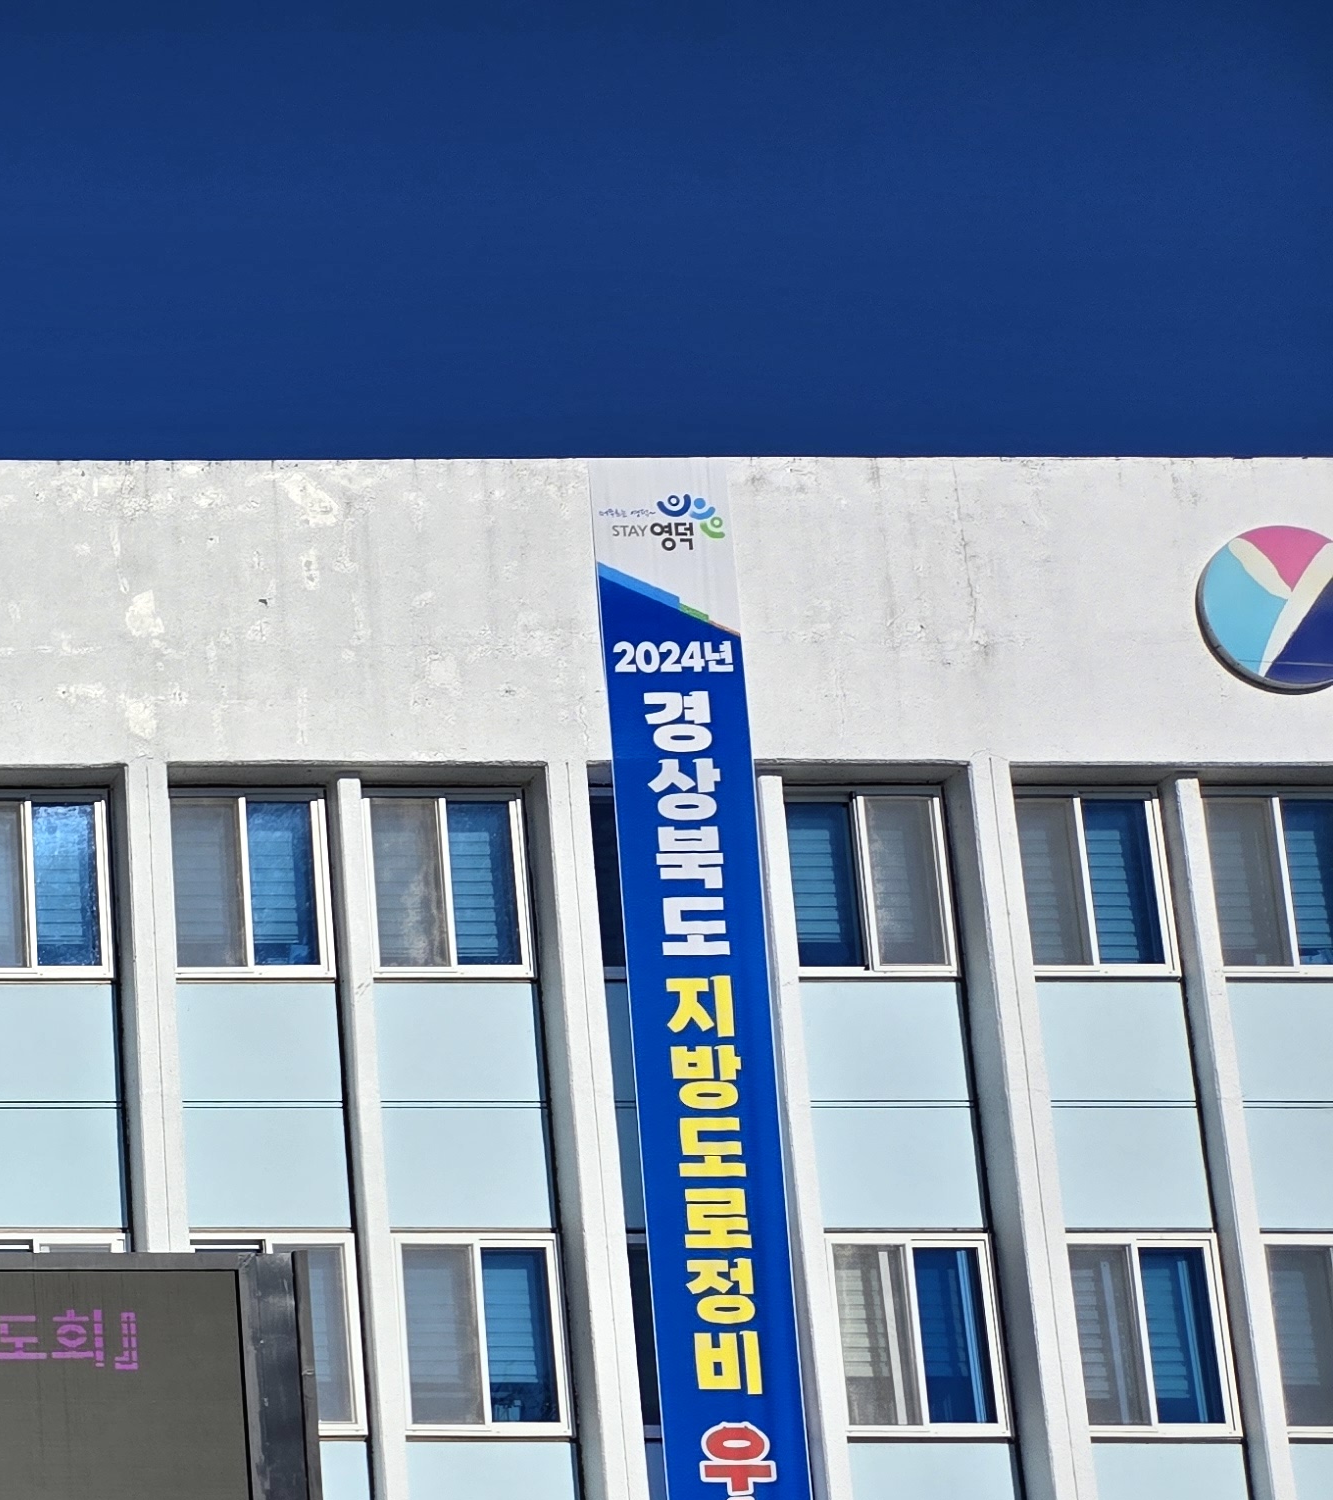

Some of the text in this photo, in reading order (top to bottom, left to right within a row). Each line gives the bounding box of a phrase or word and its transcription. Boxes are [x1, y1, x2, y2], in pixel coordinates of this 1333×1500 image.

[612, 522, 694, 551] STAY 영덕
[612, 640, 734, 673] 2024년
[643, 691, 731, 957] 경상북도
[666, 975, 763, 1395] 지방도로정비
